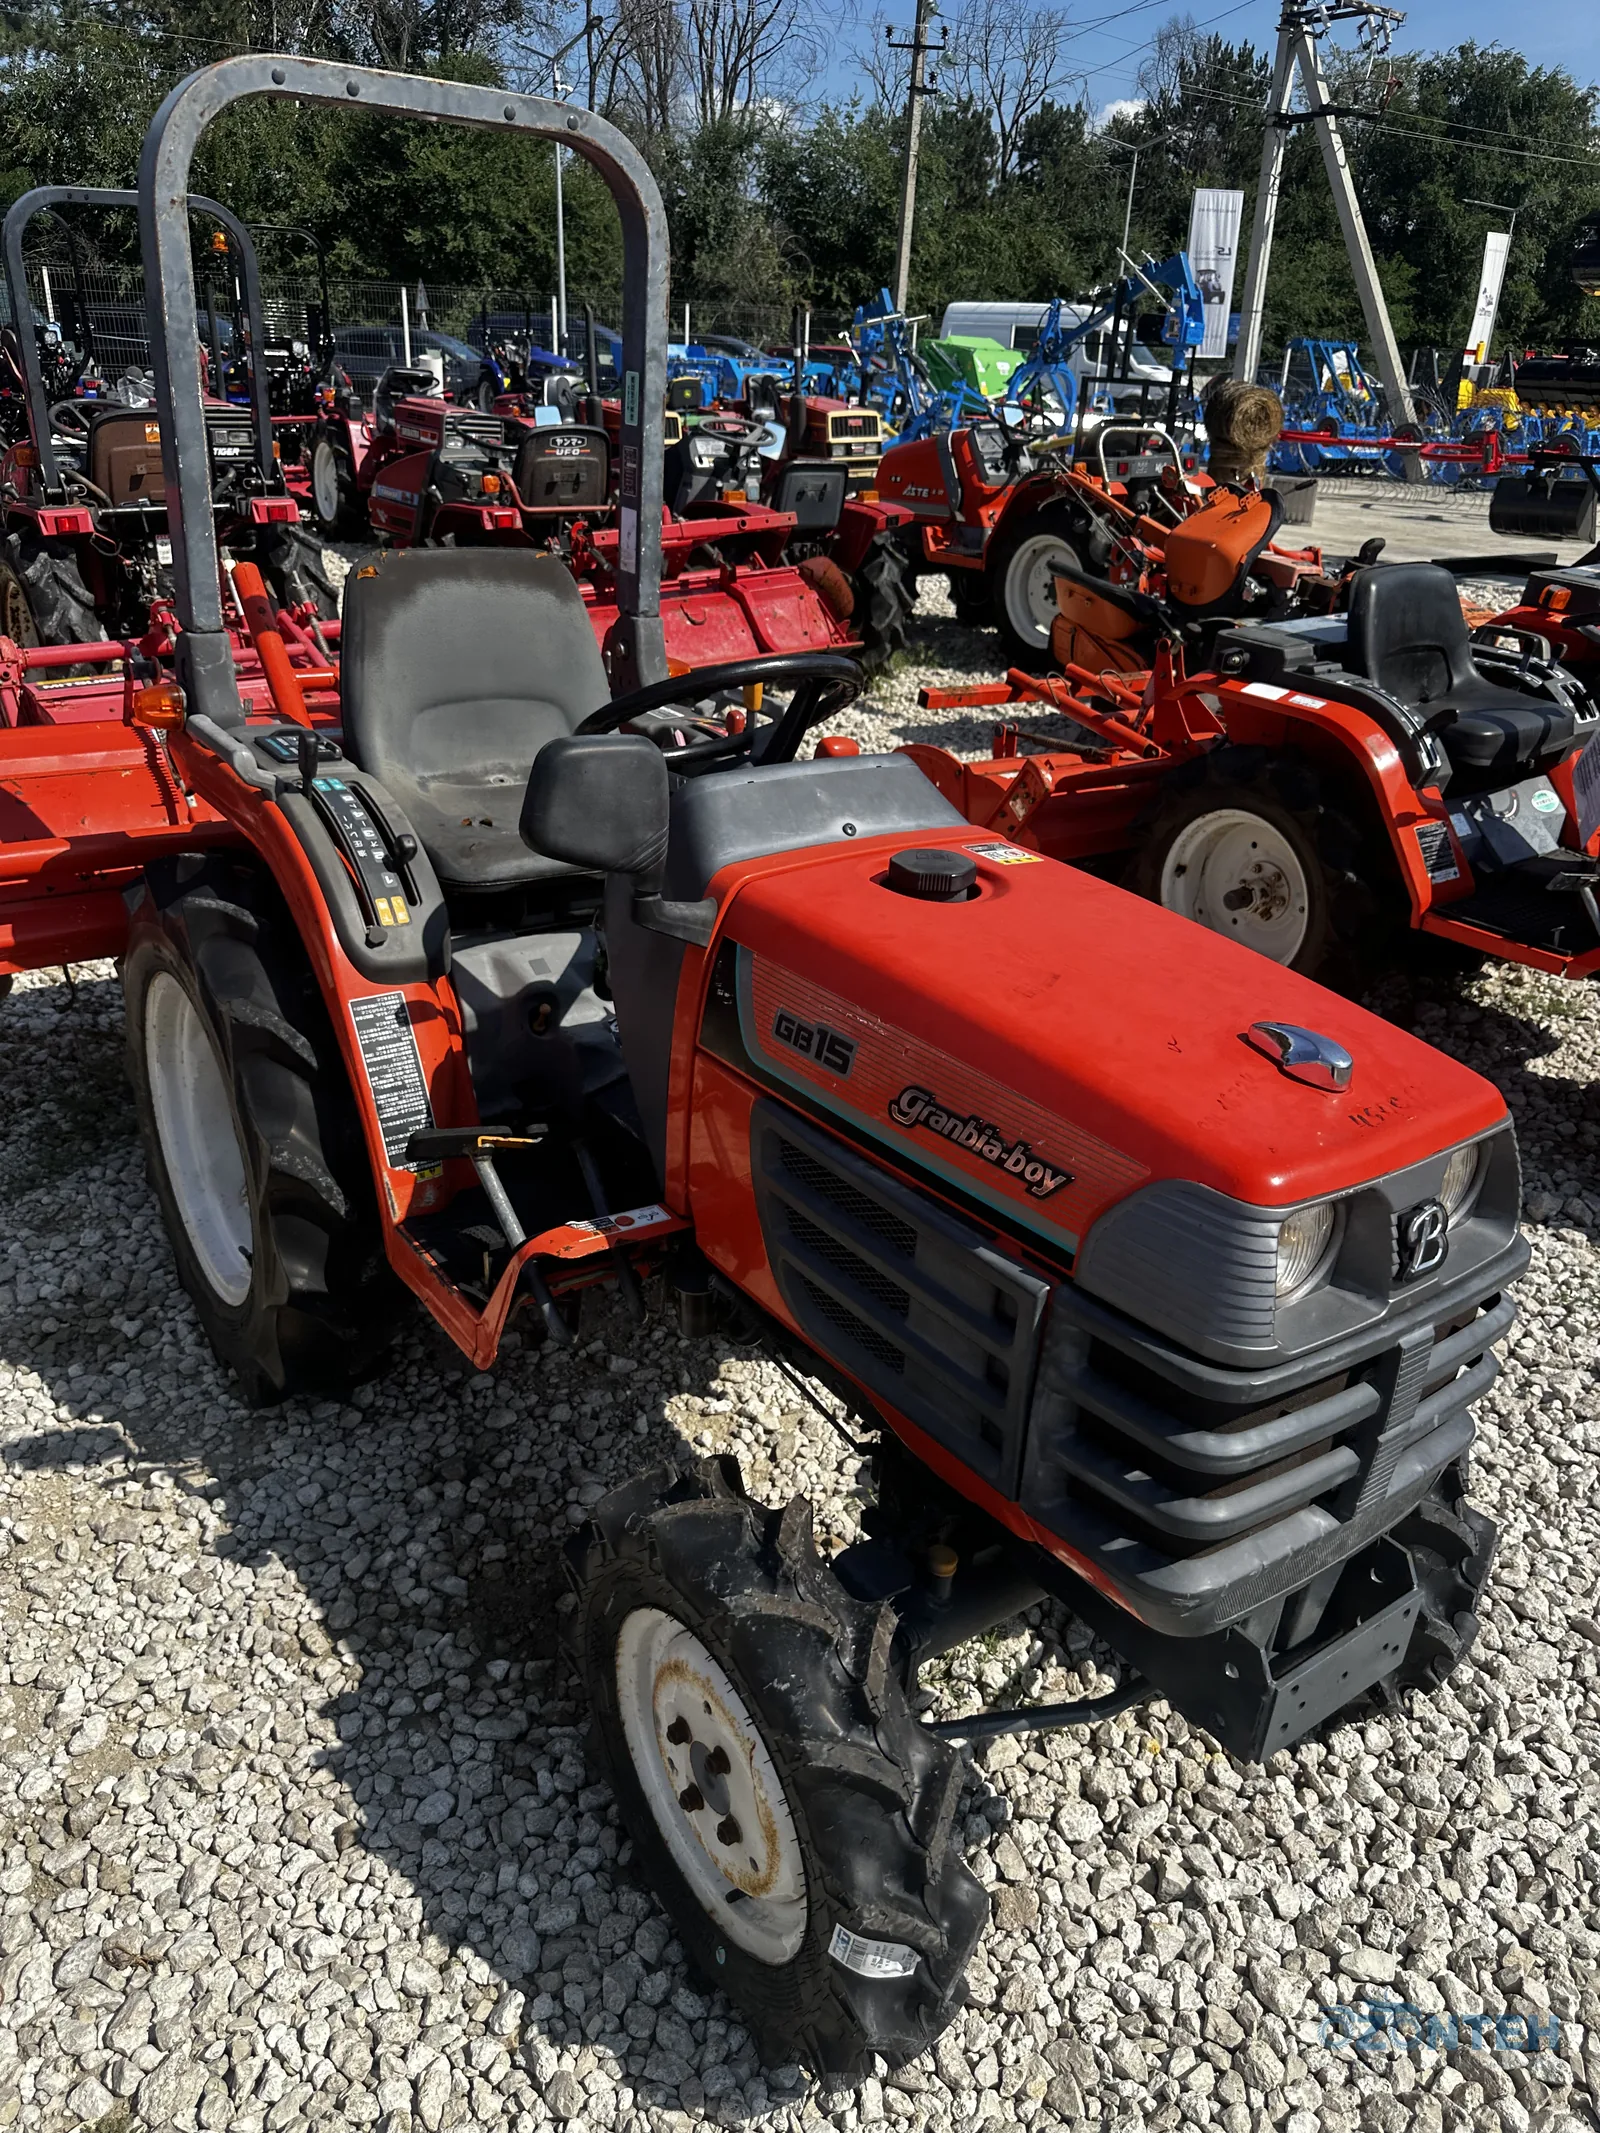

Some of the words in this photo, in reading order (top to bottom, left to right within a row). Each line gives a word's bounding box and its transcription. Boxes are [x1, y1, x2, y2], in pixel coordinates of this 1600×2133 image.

[213, 447, 240, 456] TIGER
[555, 438, 582, 446] ヤンマー
[776, 1011, 855, 1075] GB15
[890, 1087, 1067, 1197] Granbia-boy
[1407, 1205, 1445, 1274] B
[834, 1928, 852, 1959] BKT
